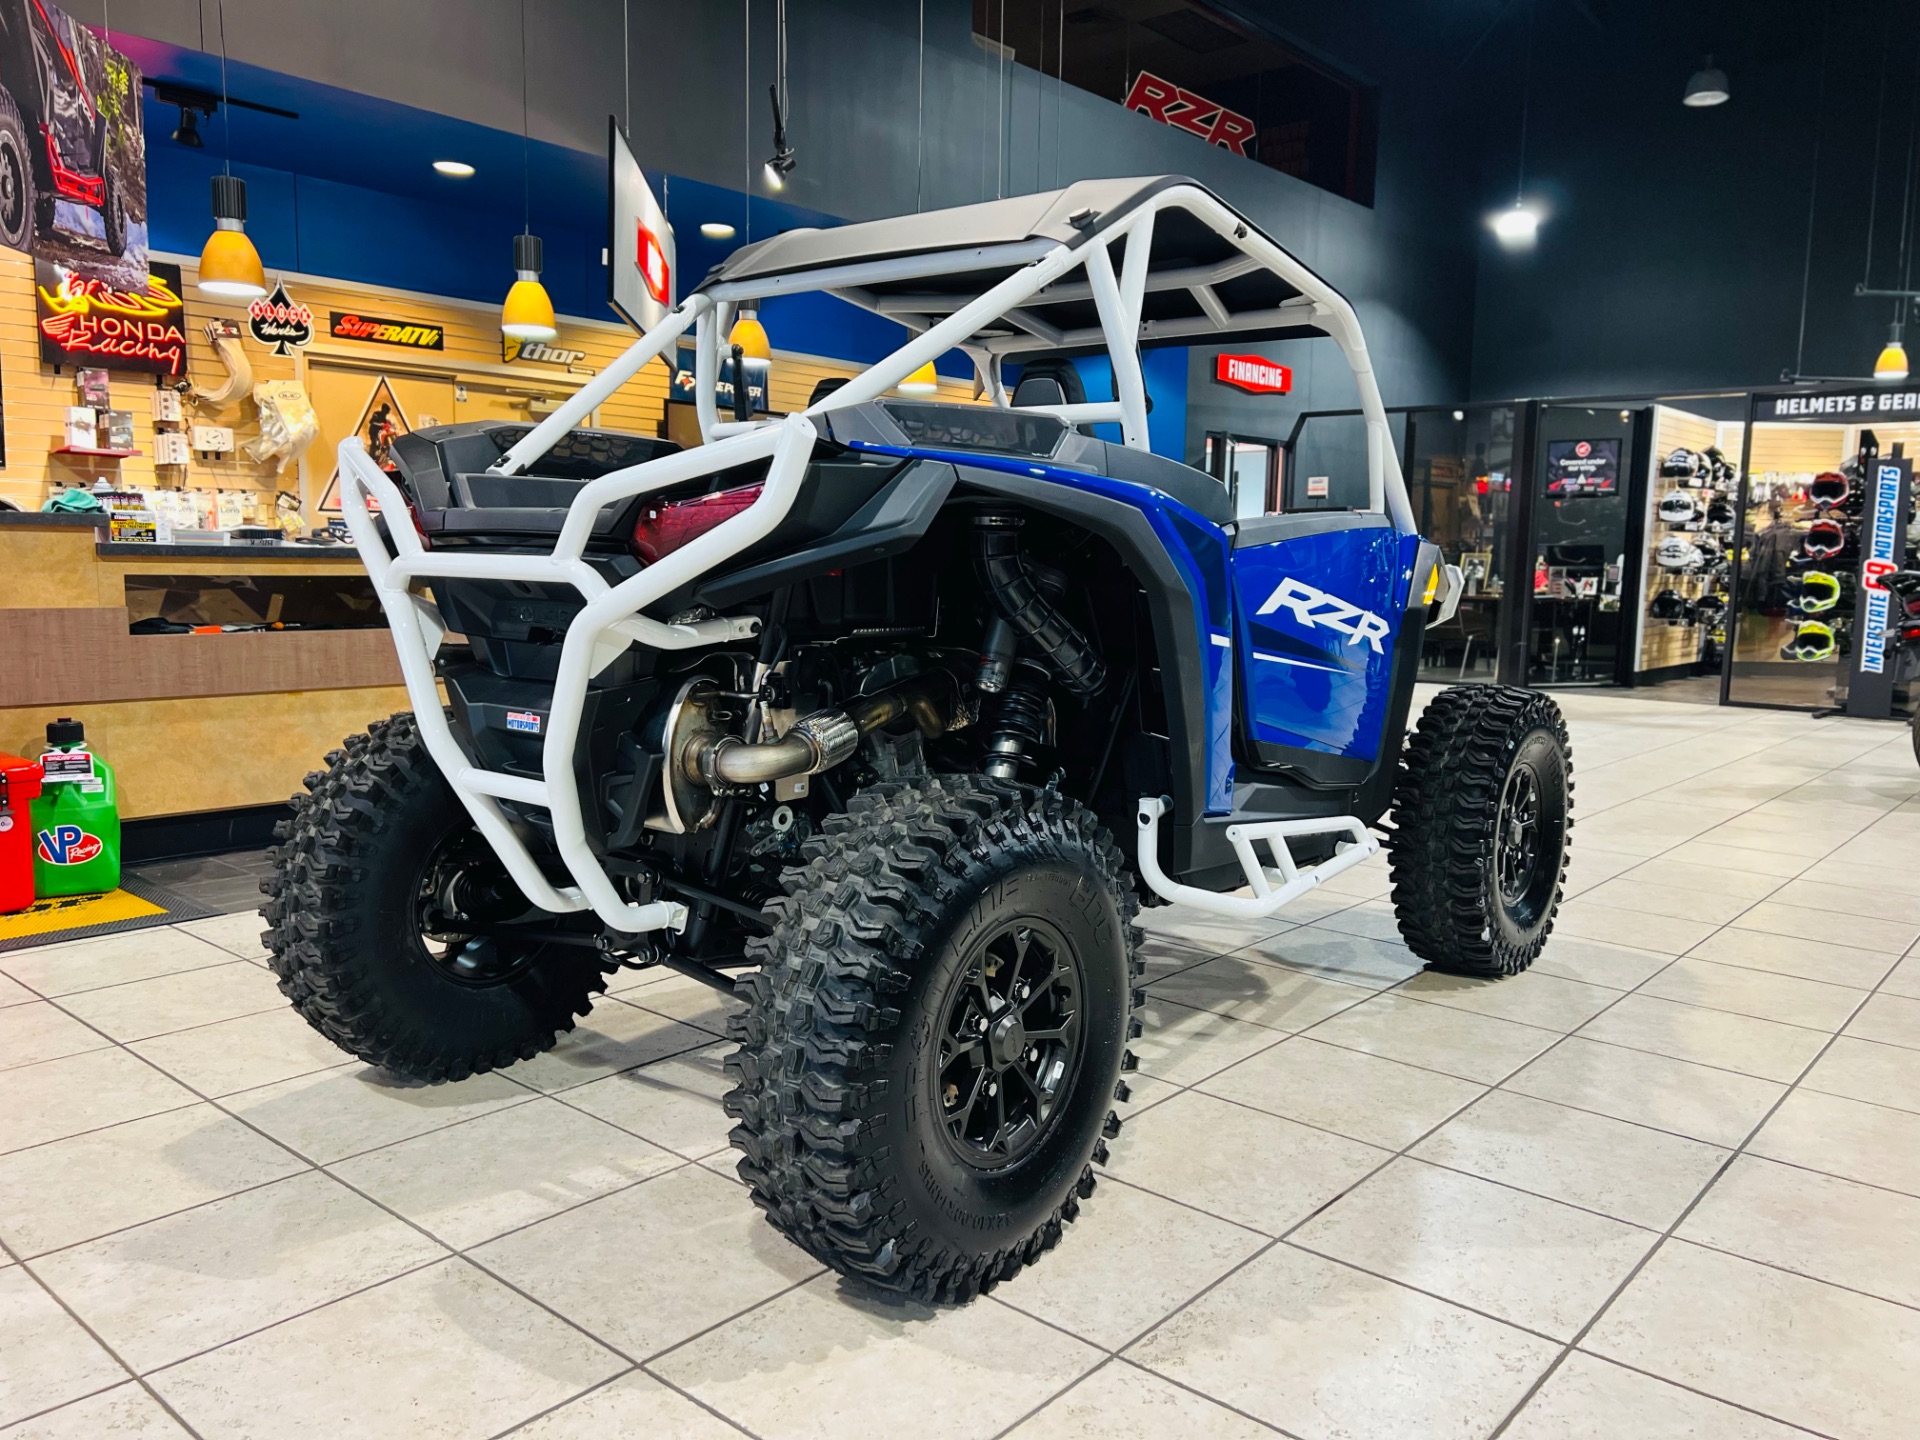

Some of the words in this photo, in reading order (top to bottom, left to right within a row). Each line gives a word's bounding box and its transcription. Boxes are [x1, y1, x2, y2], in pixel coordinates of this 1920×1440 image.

[1123, 69, 1257, 158] RZR
[254, 303, 311, 323] KLOCK
[80, 314, 186, 344] HONDA
[260, 321, 305, 337] Works
[60, 328, 181, 375] Racing
[521, 342, 586, 365] thor
[1228, 358, 1283, 388] FINANCING
[1775, 395, 1857, 415] HELMETS
[1860, 394, 1875, 412] &
[1878, 392, 1920, 411] GEA
[1559, 458, 1587, 466] Covered
[1873, 467, 1898, 561] MOTORSPORTS
[1255, 576, 1391, 655] RZR
[1863, 592, 1887, 672] INTERSTATE
[507, 719, 539, 732] MOTORSPORTS
[38, 825, 83, 865] VP
[70, 842, 102, 860] Racing
